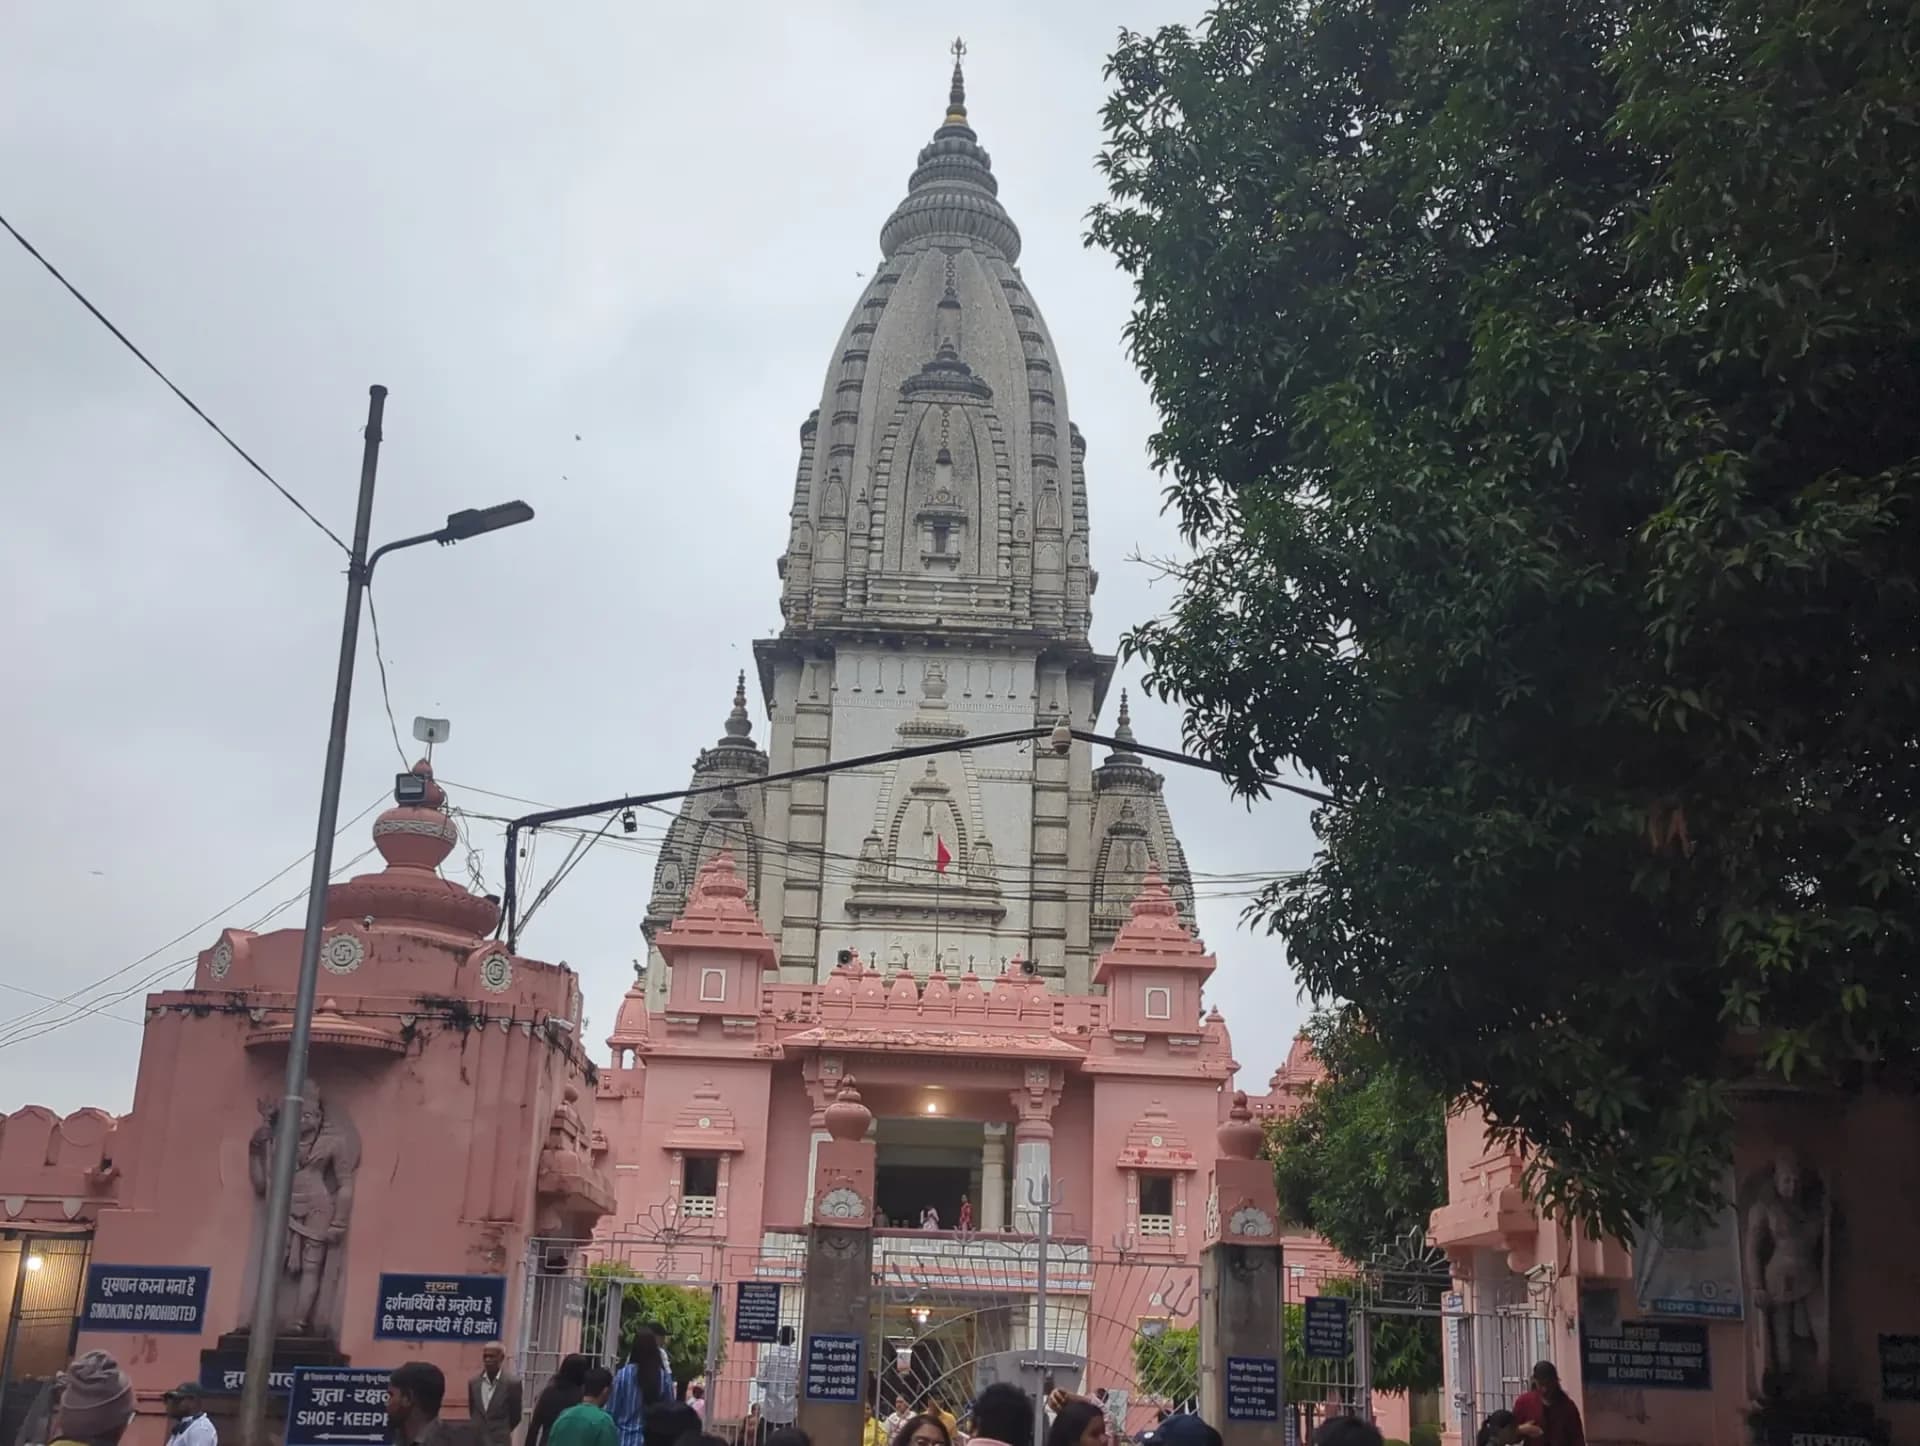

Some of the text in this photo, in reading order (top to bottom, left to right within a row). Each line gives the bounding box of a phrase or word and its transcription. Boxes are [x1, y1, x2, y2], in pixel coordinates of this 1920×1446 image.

[138, 1278, 165, 1294] करना
[165, 1279, 185, 1295] मना
[186, 1276, 196, 1297] है
[90, 1302, 197, 1321] SMOKING IS PROHIBITED
[435, 1295, 446, 1312] से
[447, 1296, 482, 1316] अनुरोध
[484, 1296, 492, 1315] है
[382, 1315, 395, 1331] कि
[452, 1317, 461, 1333] में
[463, 1318, 475, 1336] ही
[1588, 1338, 1641, 1351] TRAVELLERS
